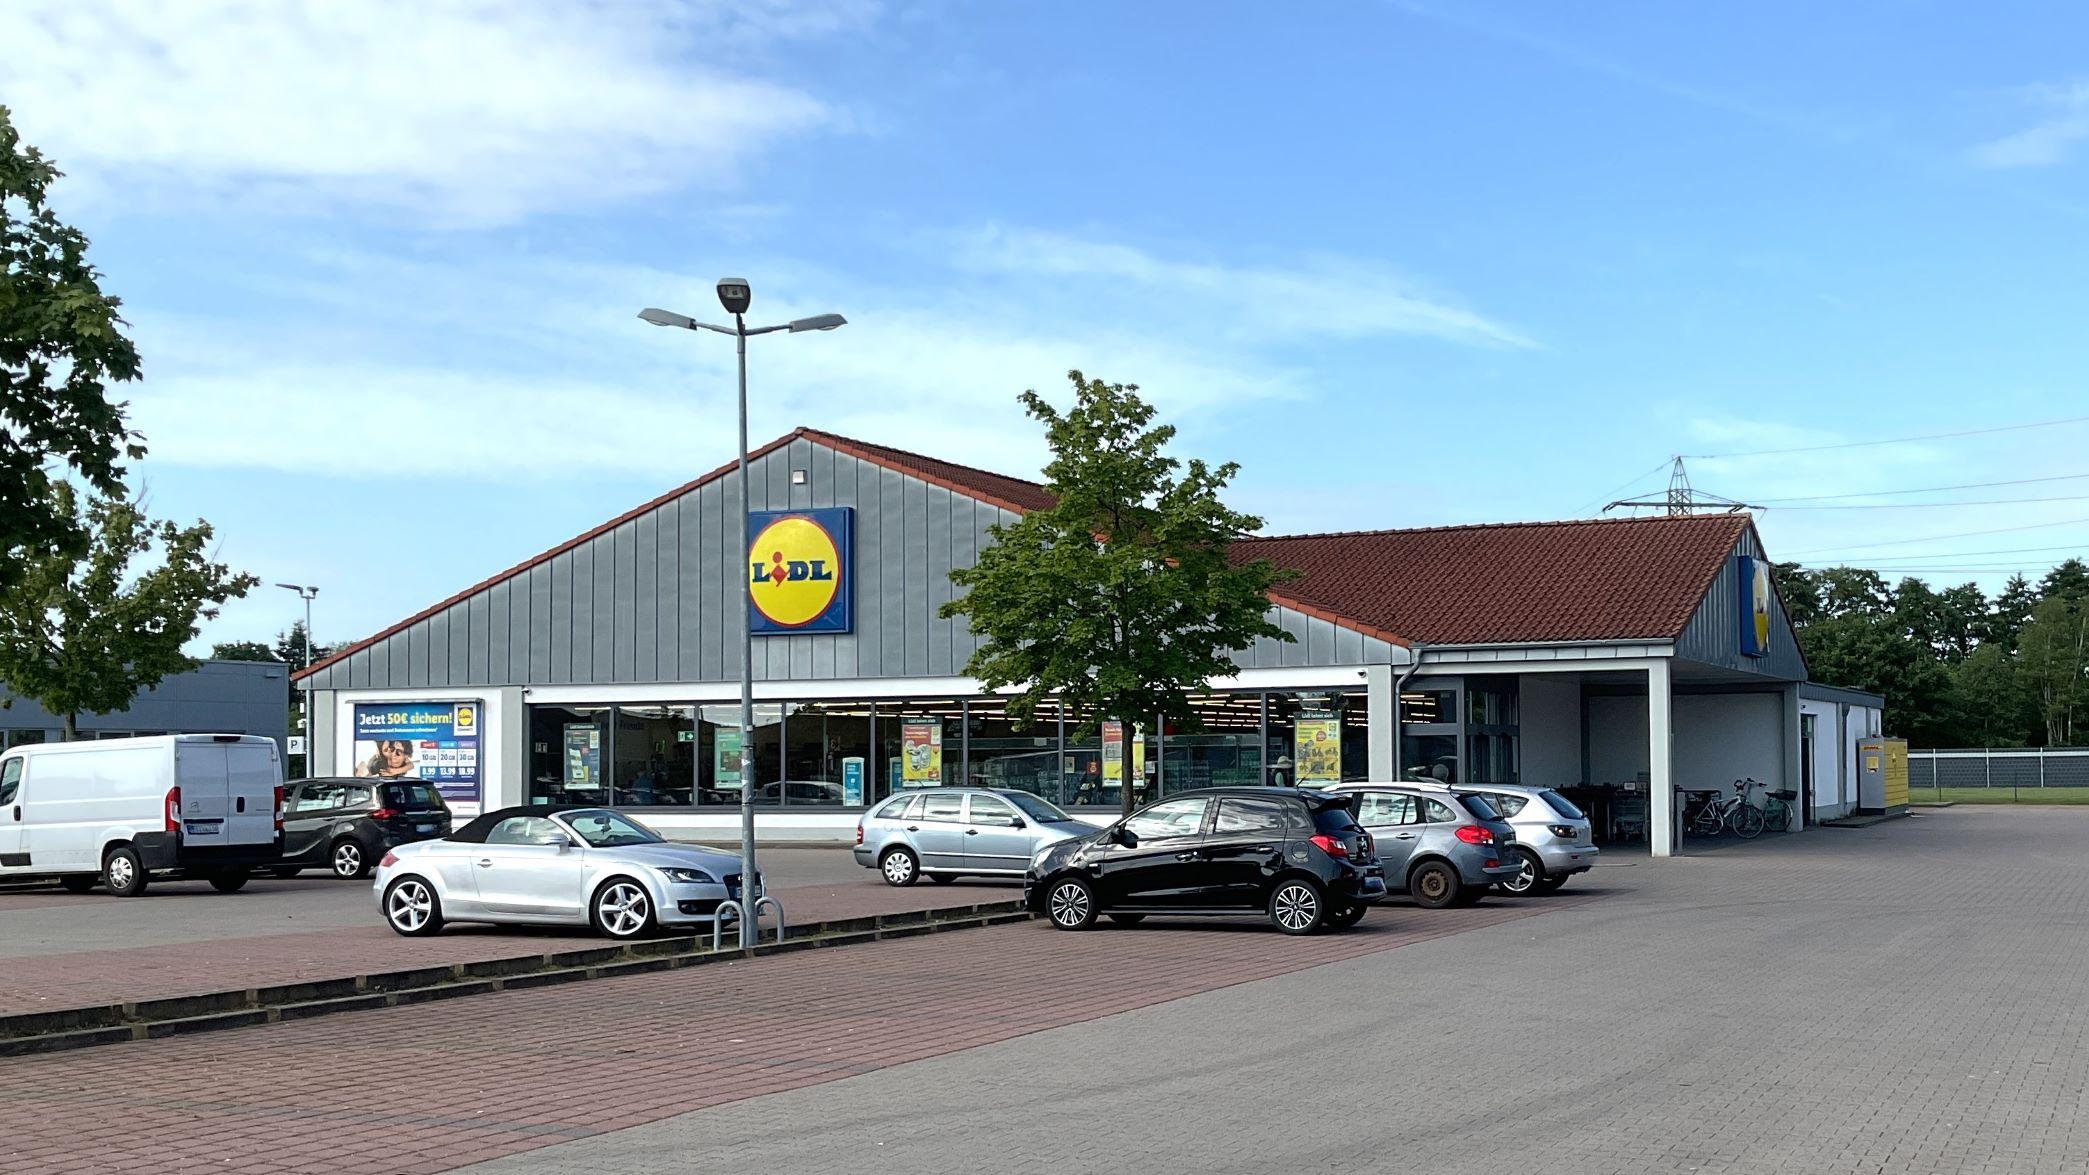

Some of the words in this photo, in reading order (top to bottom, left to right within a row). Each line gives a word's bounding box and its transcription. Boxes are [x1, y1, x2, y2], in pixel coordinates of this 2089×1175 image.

[360, 714, 386, 724] Jetzt
[387, 713, 408, 724] 50€
[410, 712, 452, 724] sichern!
[290, 740, 298, 749] P
